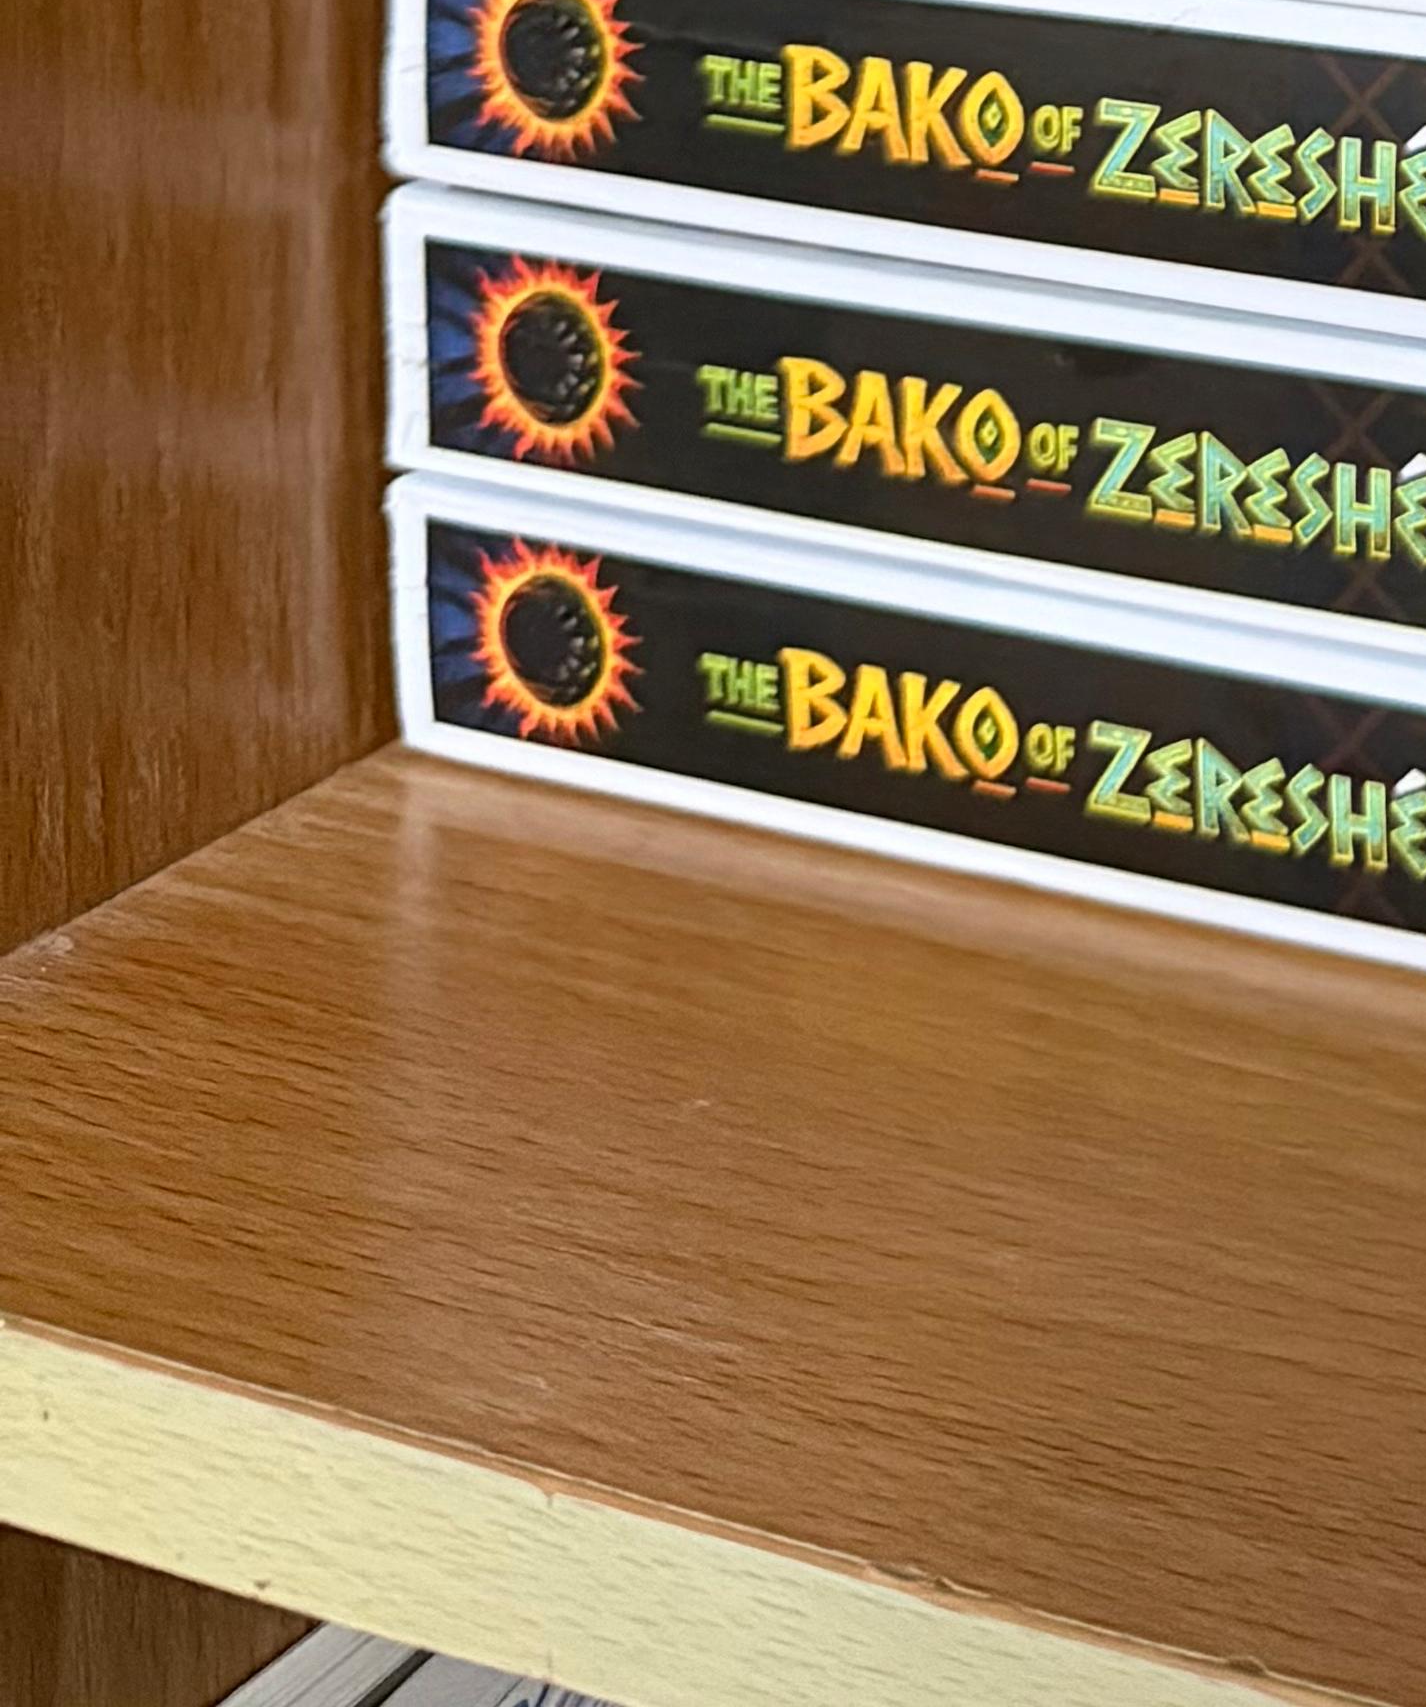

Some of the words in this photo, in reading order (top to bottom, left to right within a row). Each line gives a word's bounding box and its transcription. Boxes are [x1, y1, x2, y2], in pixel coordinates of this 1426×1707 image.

[702, 55, 781, 110] THE
[782, 44, 1024, 169] BAKO
[1032, 105, 1083, 154] OF
[698, 365, 778, 420] THE
[779, 357, 1021, 485] BAKO
[1028, 423, 1079, 471] OF
[701, 653, 778, 710] THE
[779, 648, 1019, 779] BAKO
[1026, 723, 1075, 772] OF
